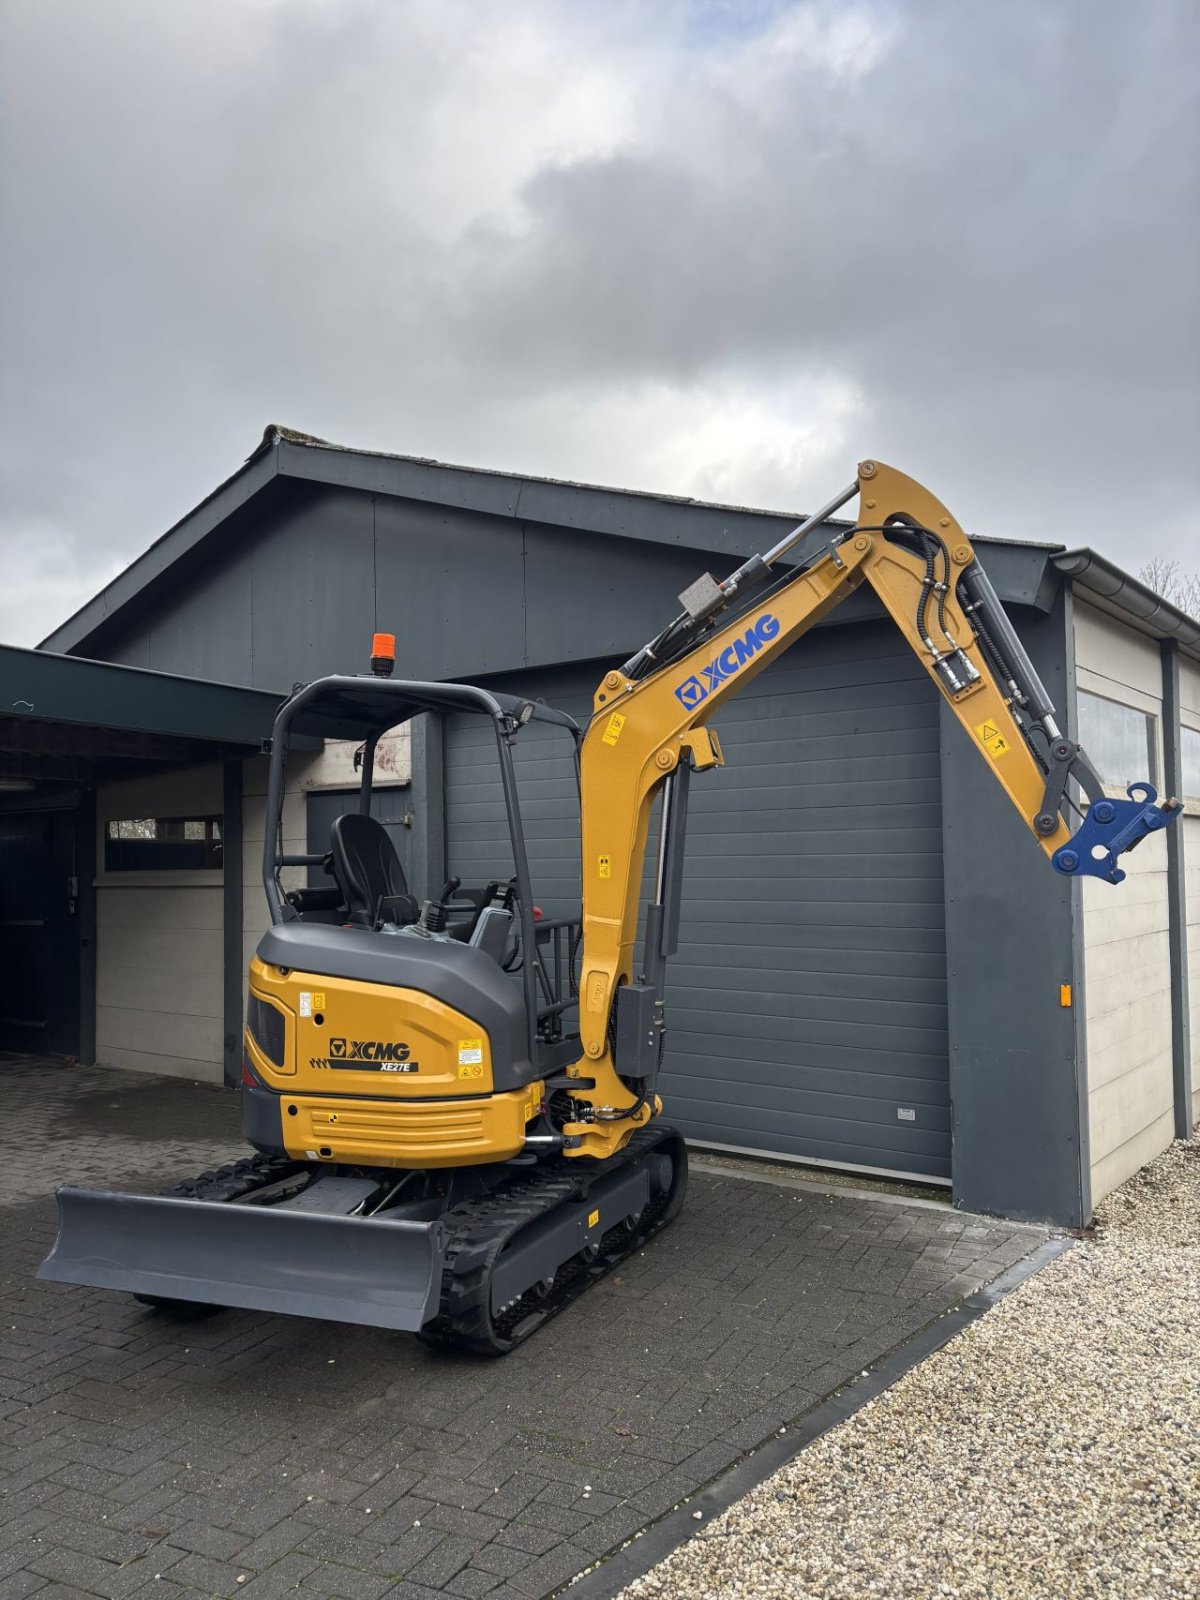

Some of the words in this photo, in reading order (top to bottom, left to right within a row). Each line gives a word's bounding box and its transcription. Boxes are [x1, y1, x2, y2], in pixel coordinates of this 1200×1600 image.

[700, 614, 780, 693] XCMG
[347, 1041, 410, 1061] XCMG
[380, 1062, 410, 1072] XE27E
